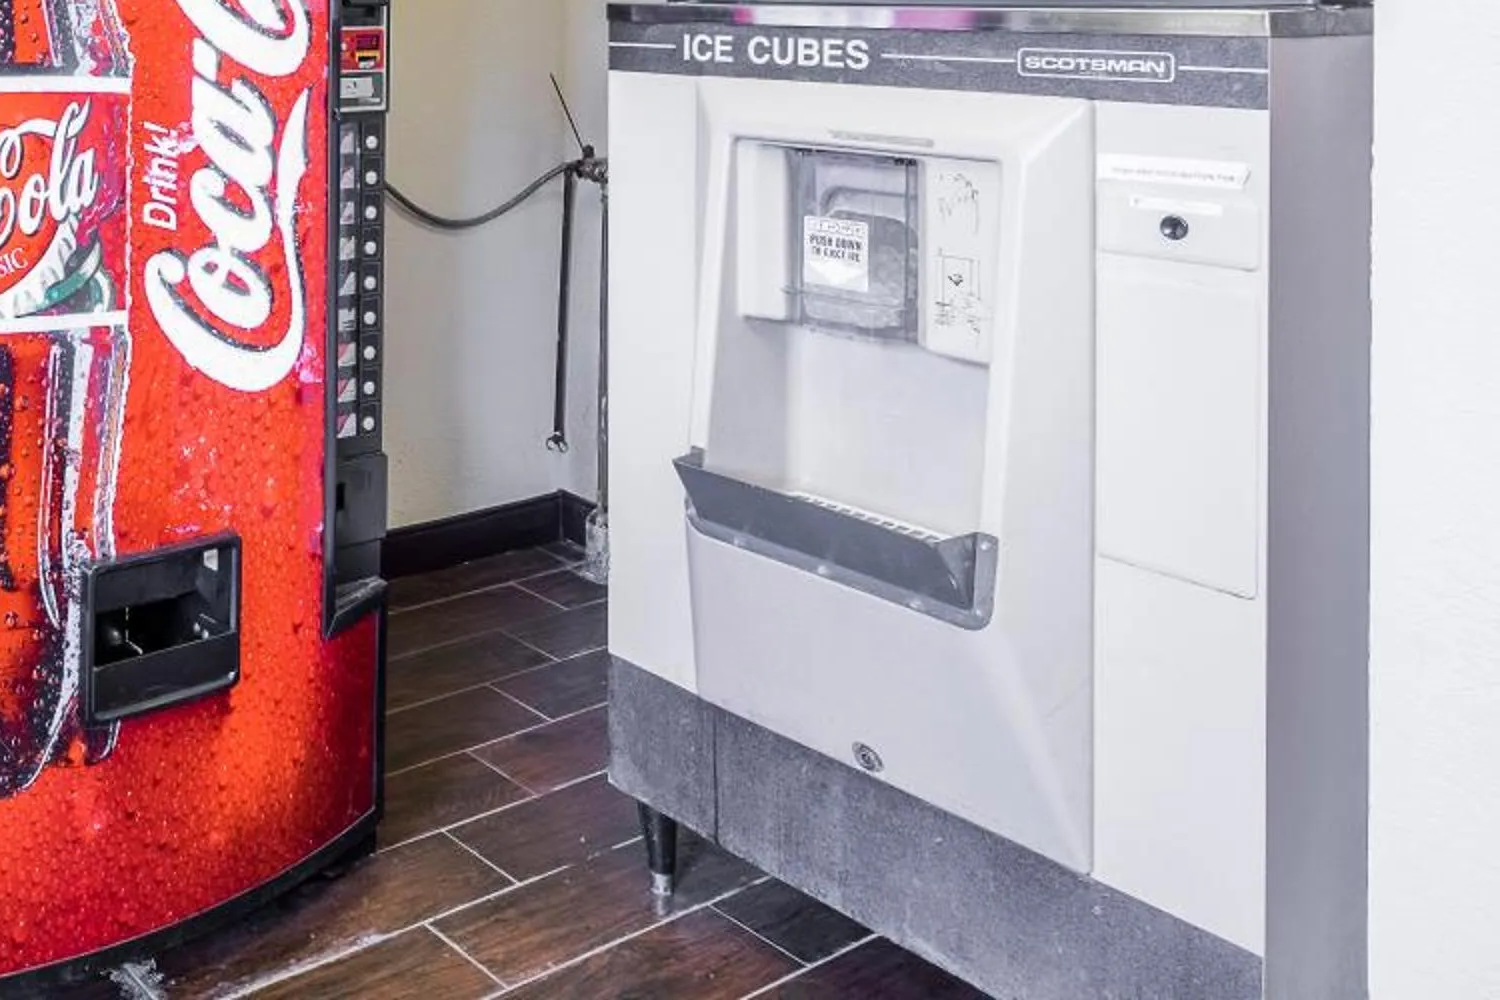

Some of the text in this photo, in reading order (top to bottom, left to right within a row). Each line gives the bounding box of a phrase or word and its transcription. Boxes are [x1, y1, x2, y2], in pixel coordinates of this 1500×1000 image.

[681, 33, 871, 70] ICE CUBES
[1024, 55, 1167, 78] SCOTSMAN
[143, 120, 180, 232] Drink!
